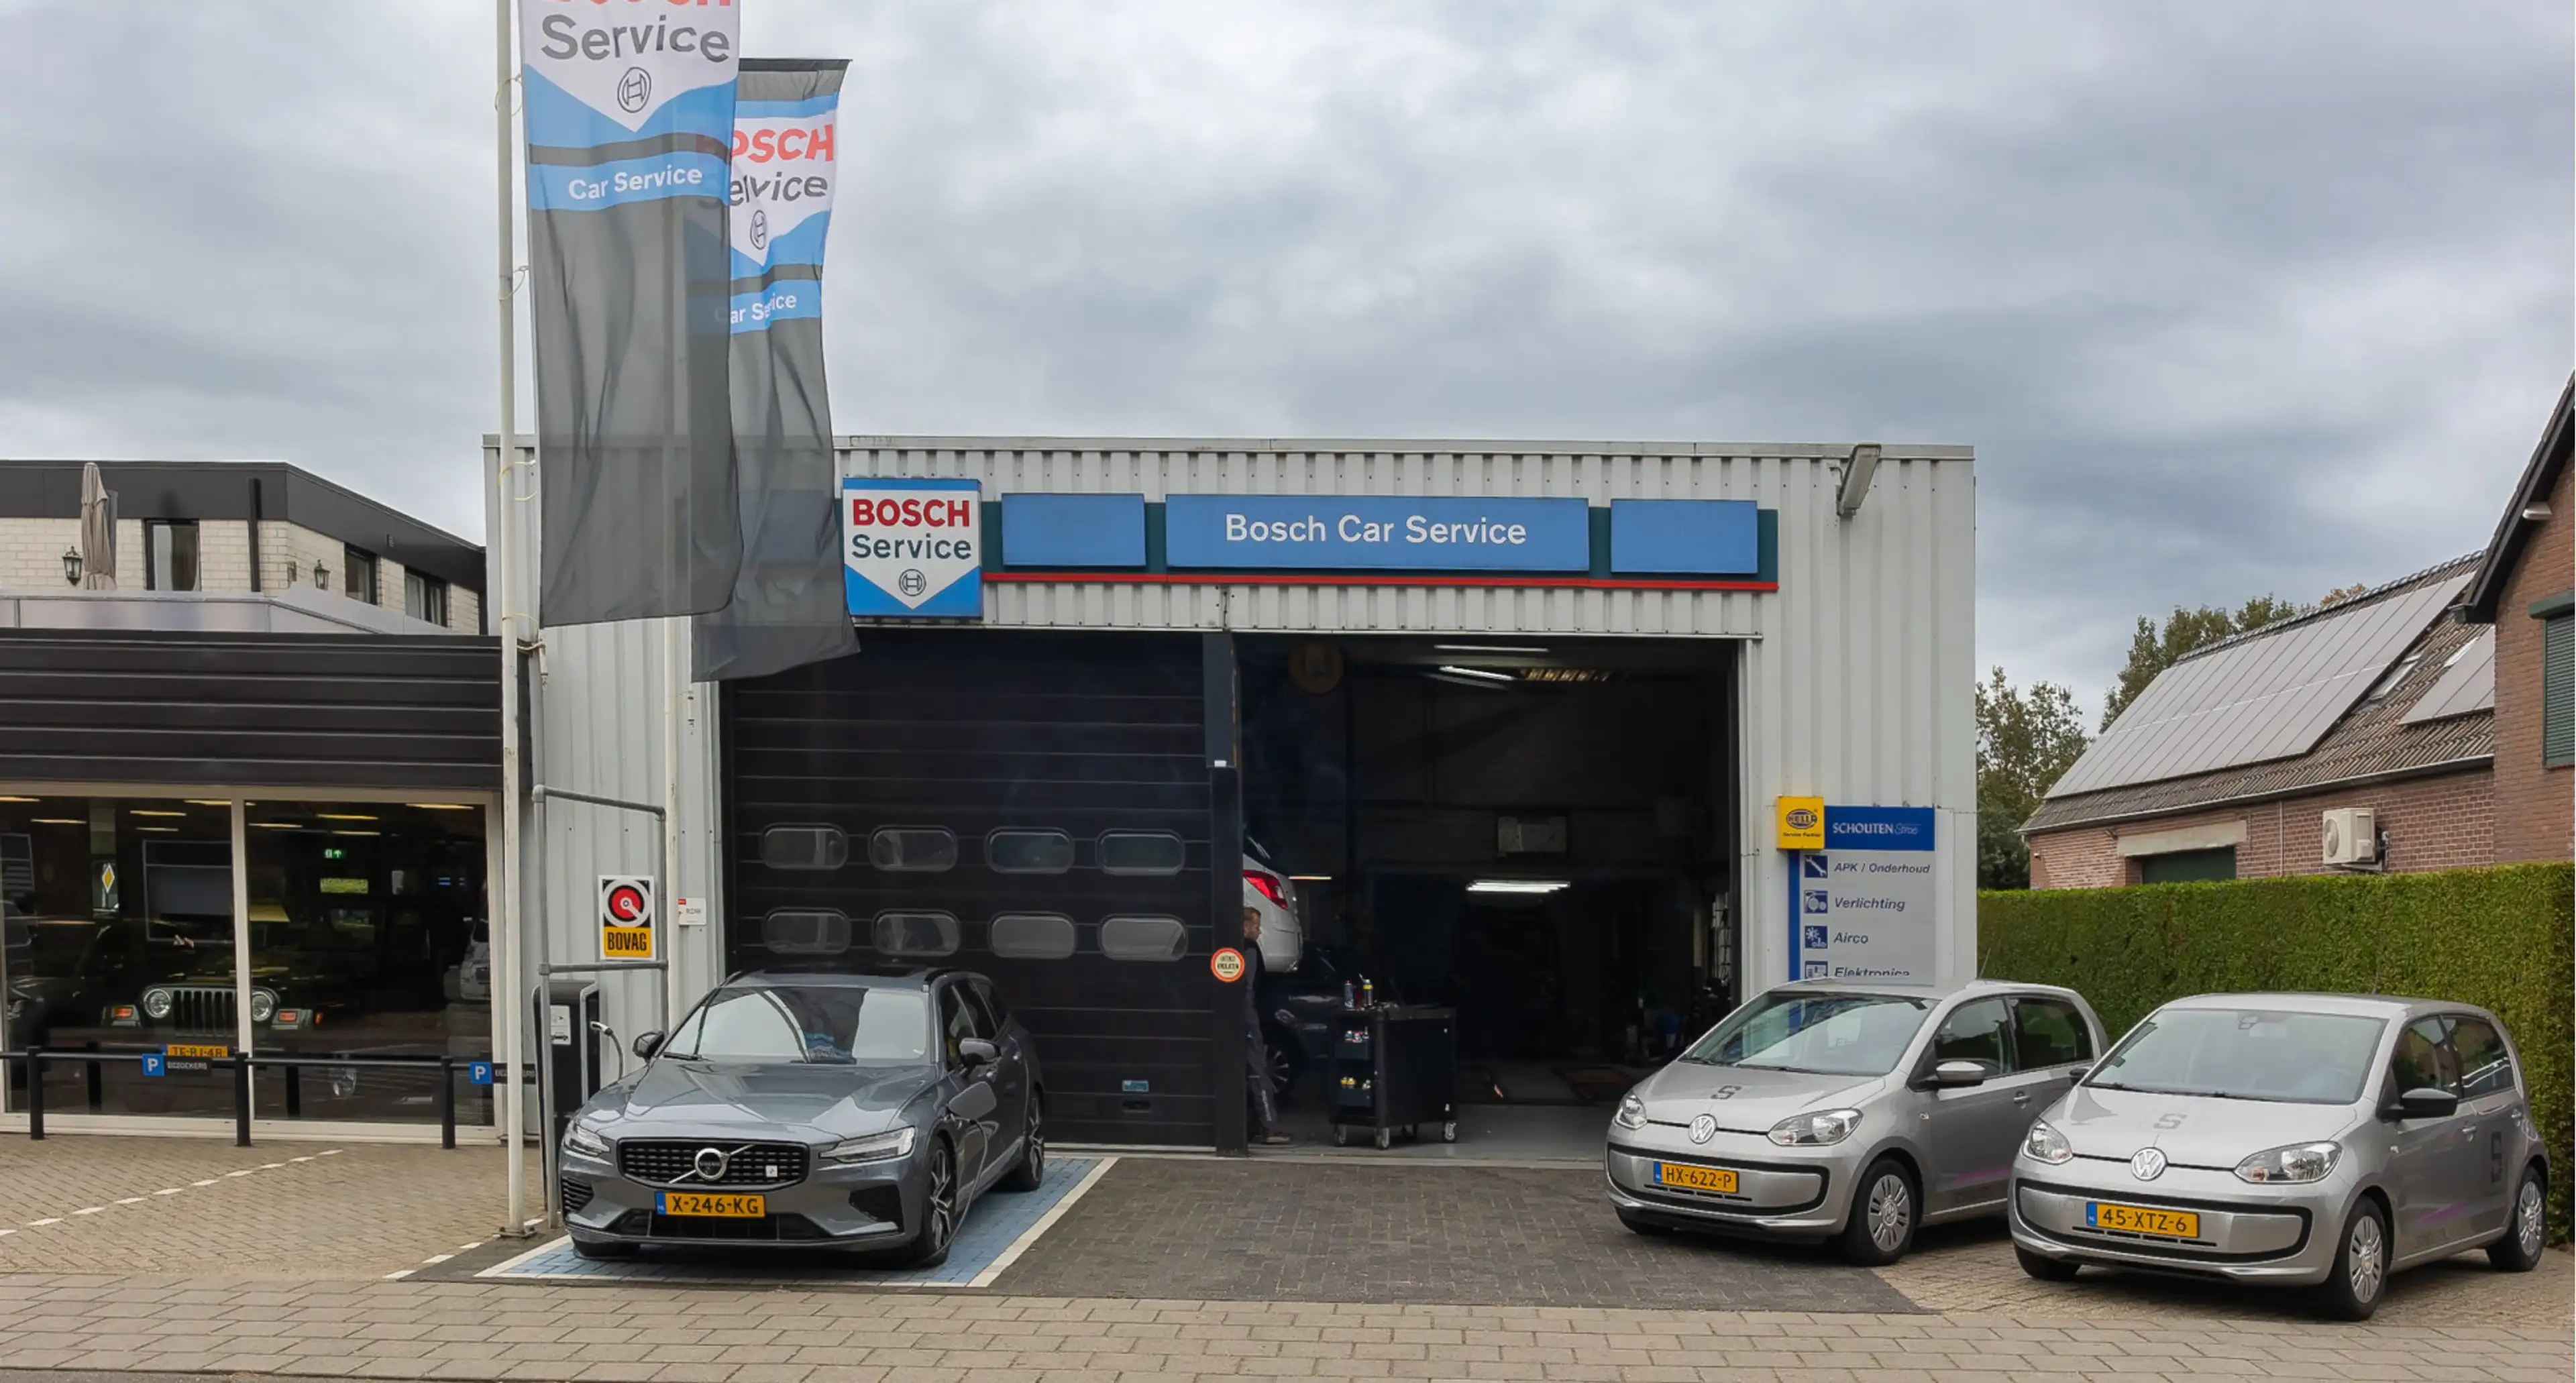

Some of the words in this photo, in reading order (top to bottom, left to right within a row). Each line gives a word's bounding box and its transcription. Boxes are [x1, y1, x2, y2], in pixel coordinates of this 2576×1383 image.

[541, 14, 730, 62] Service
[731, 123, 835, 164] OSCH
[569, 179, 608, 200] Car
[614, 165, 702, 192] Service
[731, 309, 746, 324] ar
[852, 498, 970, 527] BOSCH
[1226, 514, 1326, 542] Bosch
[1338, 515, 1394, 543] Car
[1406, 516, 1527, 544] Service
[852, 534, 972, 560] Service
[1833, 822, 1893, 834] SCHOUTEN
[1834, 863, 1858, 872] APK
[1869, 863, 1931, 873] Onderhoud
[1835, 897, 1906, 912] Verlichting
[608, 932, 647, 951] BOVAG
[1833, 932, 1869, 944] Airco
[147, 1058, 158, 1072] P
[475, 1065, 486, 1081] P
[1666, 1166, 1731, 1188] HX-622-P
[672, 1196, 759, 1214] X-246-KG
[2102, 1209, 2187, 1232] 45-XTZ-6
